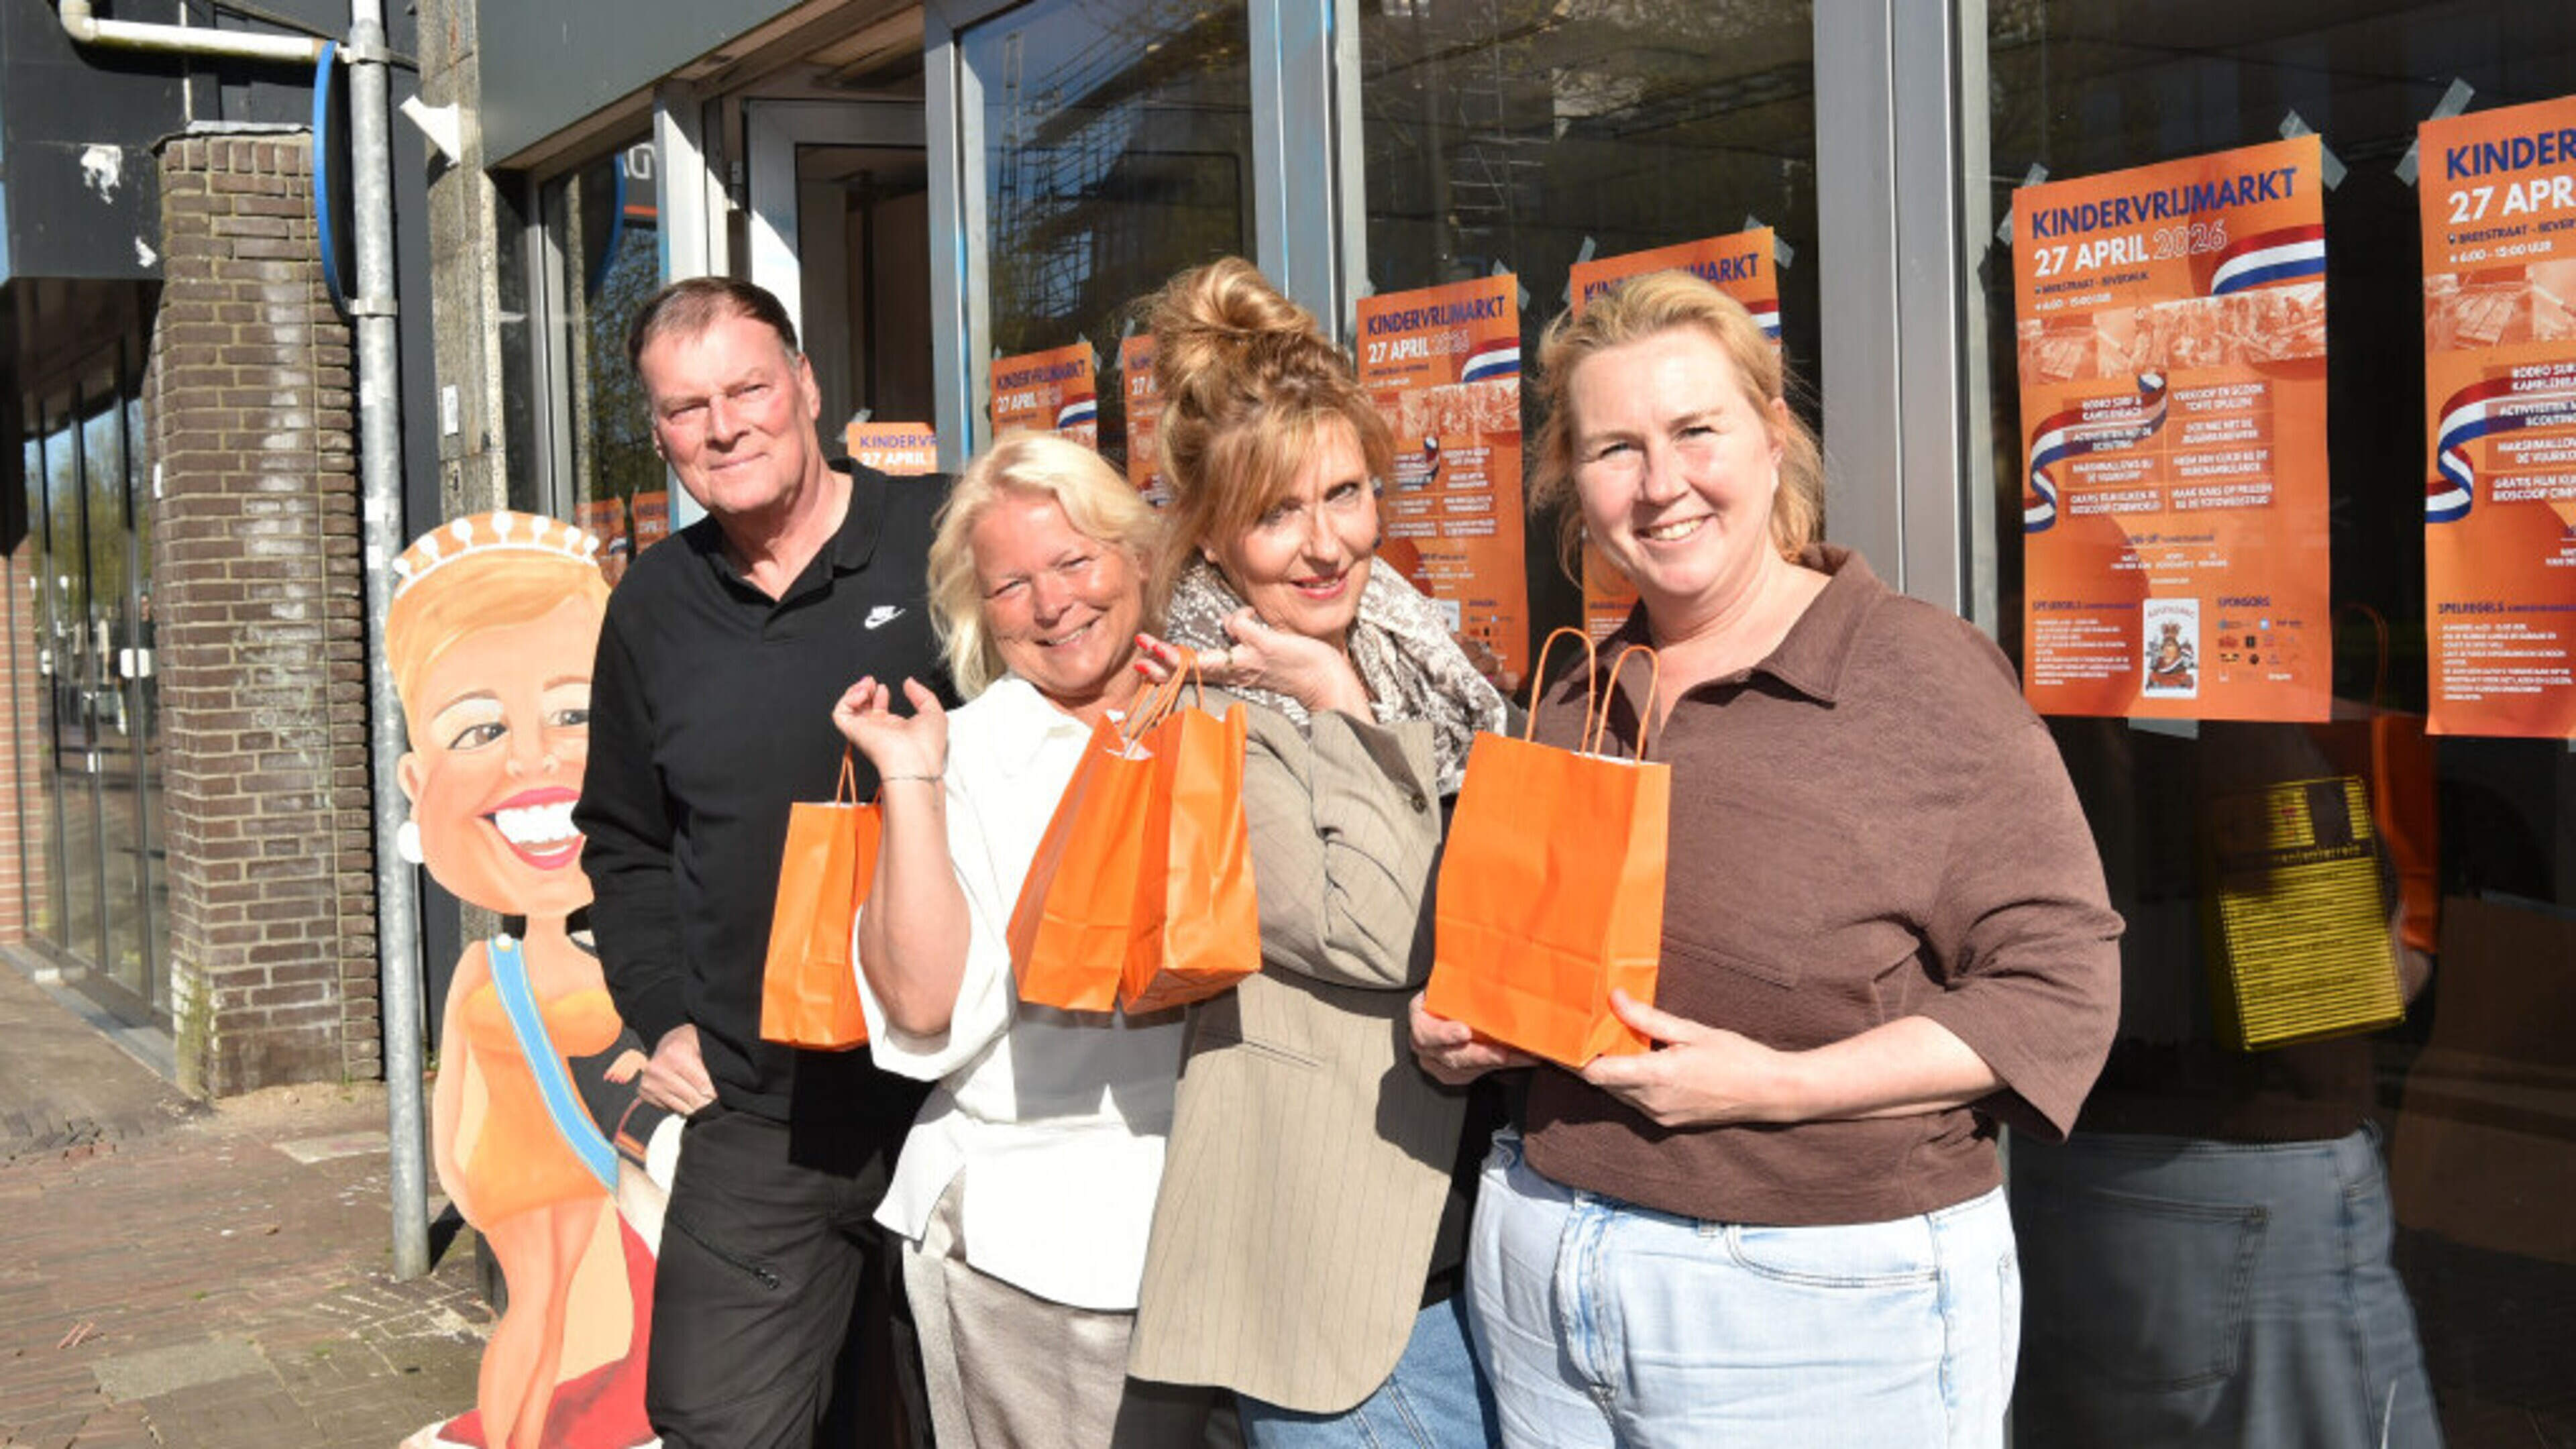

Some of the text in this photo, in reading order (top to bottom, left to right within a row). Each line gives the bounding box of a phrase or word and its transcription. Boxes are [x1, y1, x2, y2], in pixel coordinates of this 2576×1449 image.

[2031, 167, 2298, 239] KINDERVRIJMARKT
[2449, 185, 2495, 225] 27
[2033, 219, 2229, 278] 27 APRIL 2026
[1366, 294, 1505, 336] KINDERVRIJMARKT
[1368, 341, 1387, 364] 27
[1391, 336, 1430, 362] APRIL
[1011, 391, 1037, 411] APRIL
[861, 451, 925, 467] 27 APRIL
